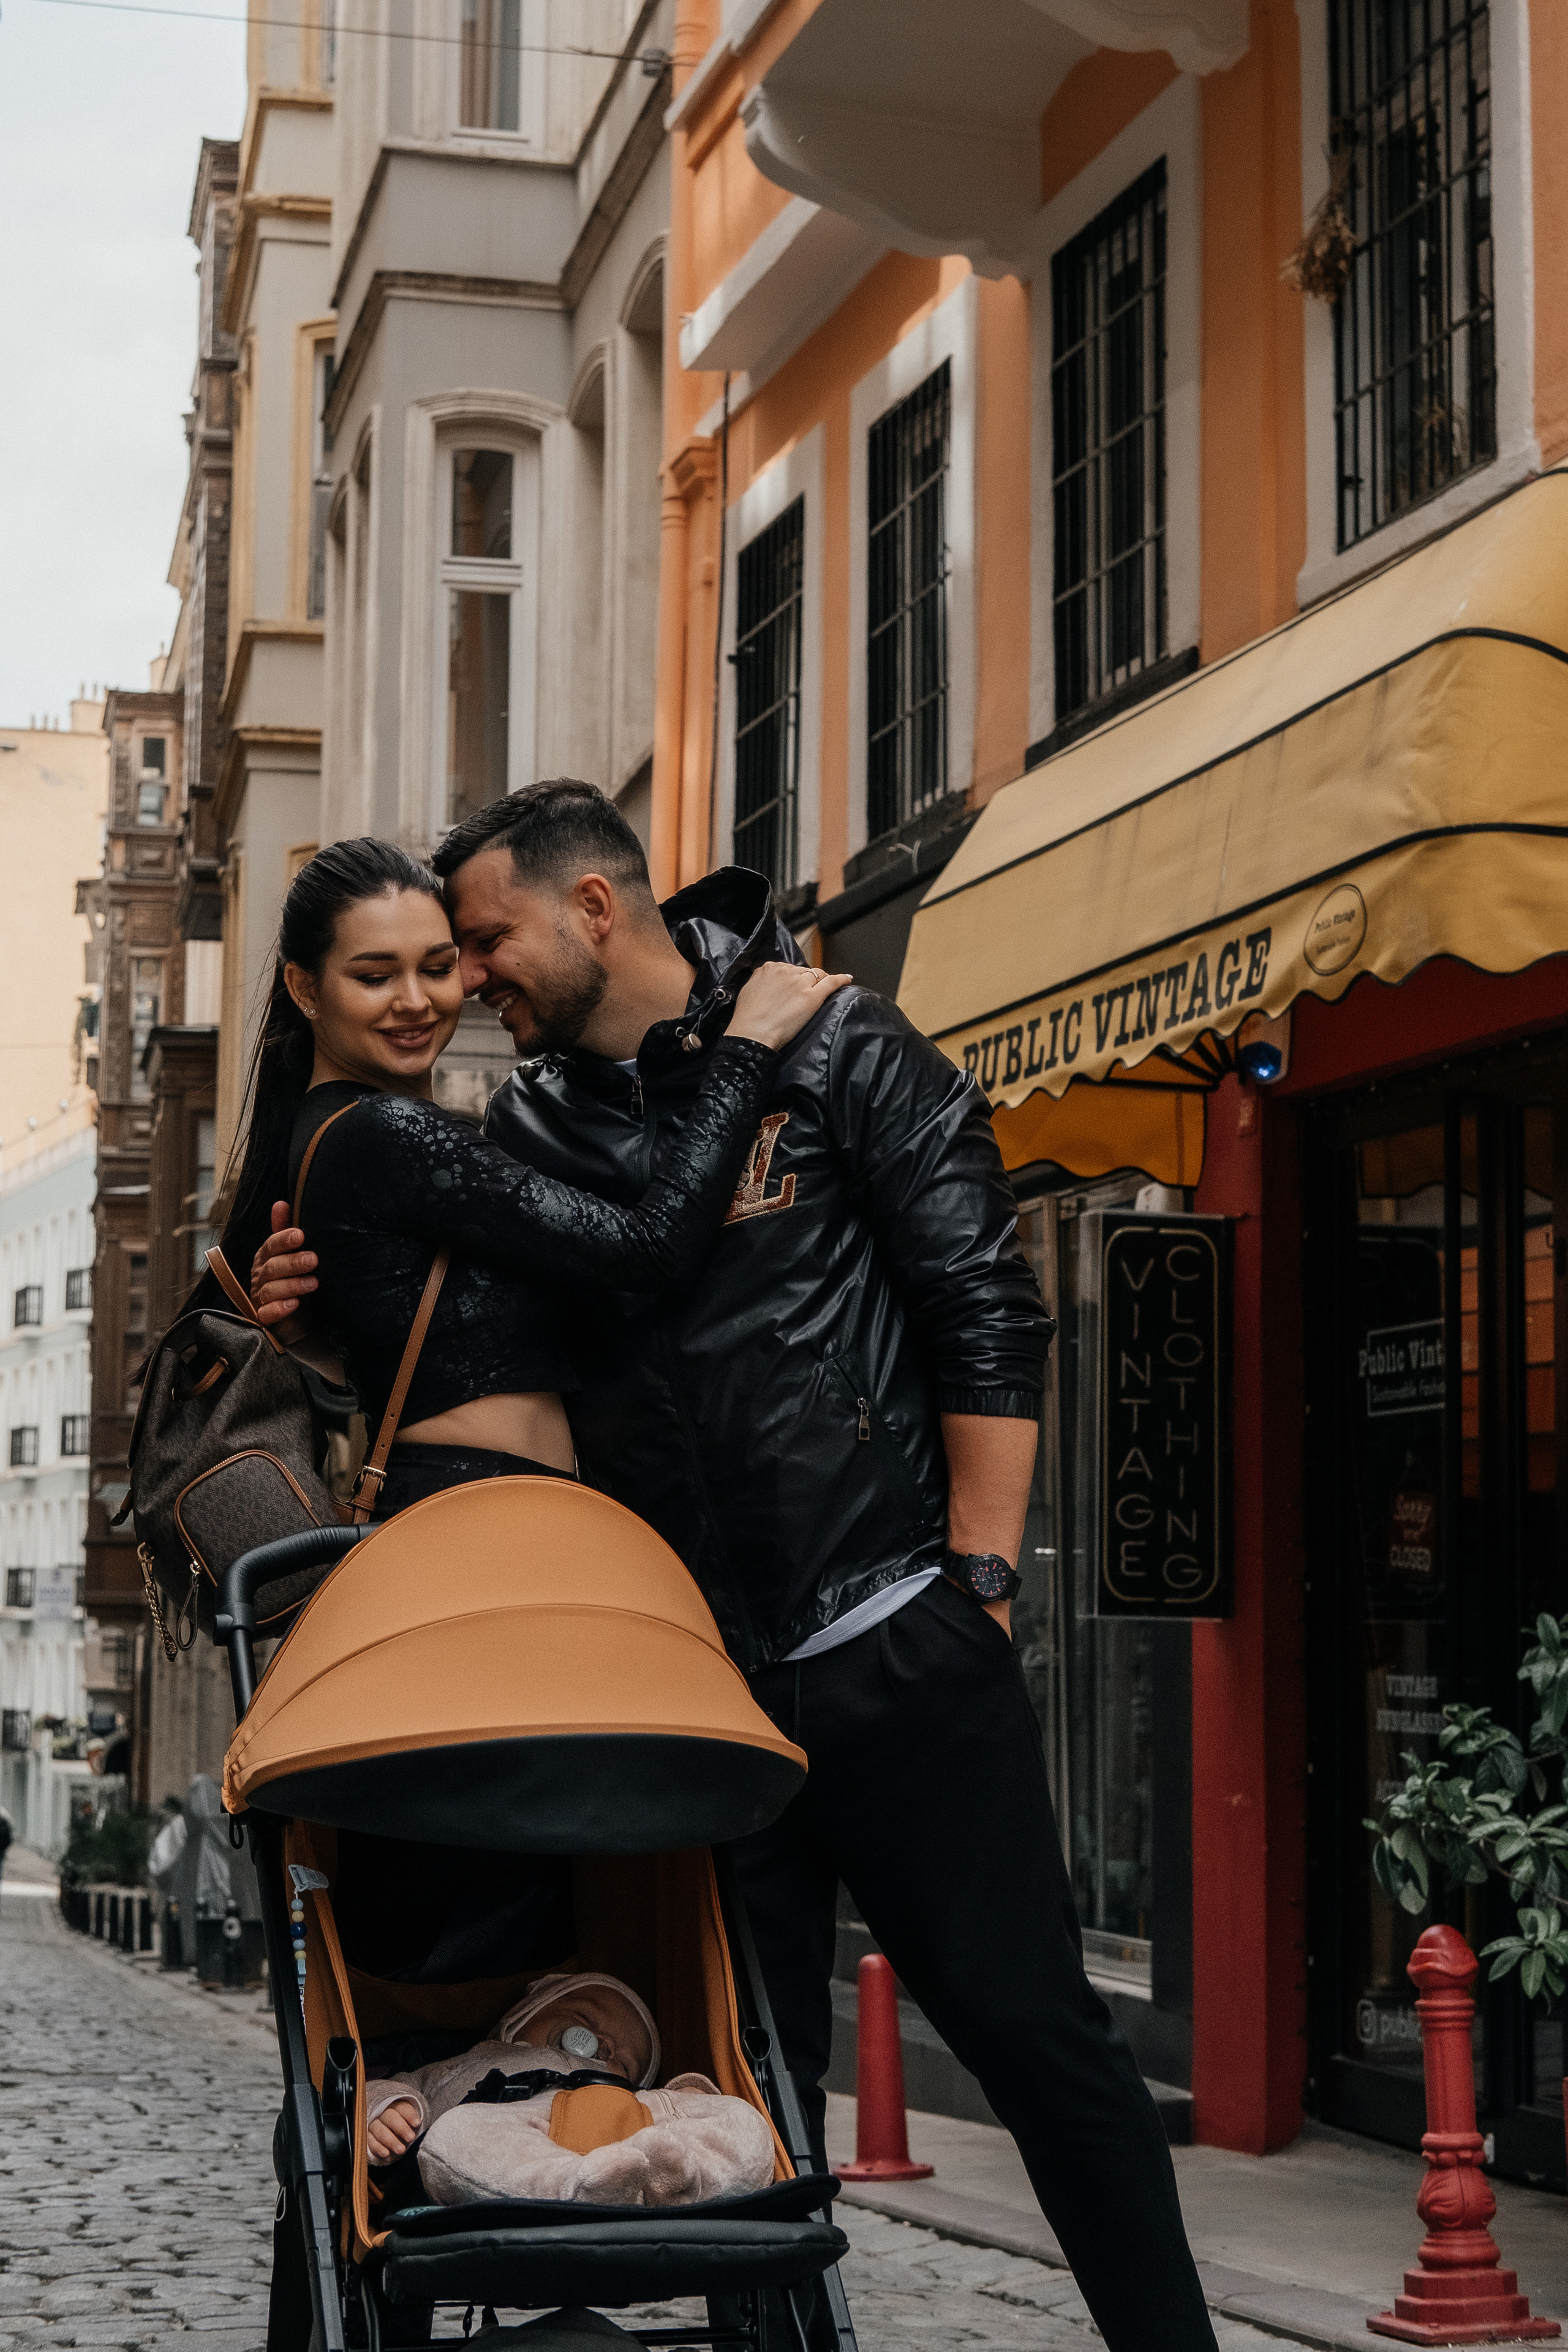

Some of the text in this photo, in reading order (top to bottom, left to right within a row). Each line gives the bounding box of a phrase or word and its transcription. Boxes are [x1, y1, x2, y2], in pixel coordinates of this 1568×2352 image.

[963, 926, 1272, 1093] PUBLIC VINTAGE
[1114, 1256, 1155, 1578] VINTAGE
[1161, 1245, 1206, 1591] CLOTHING
[1358, 1338, 1446, 1378] Public Vint
[1389, 1544, 1431, 1572] CLOSED
